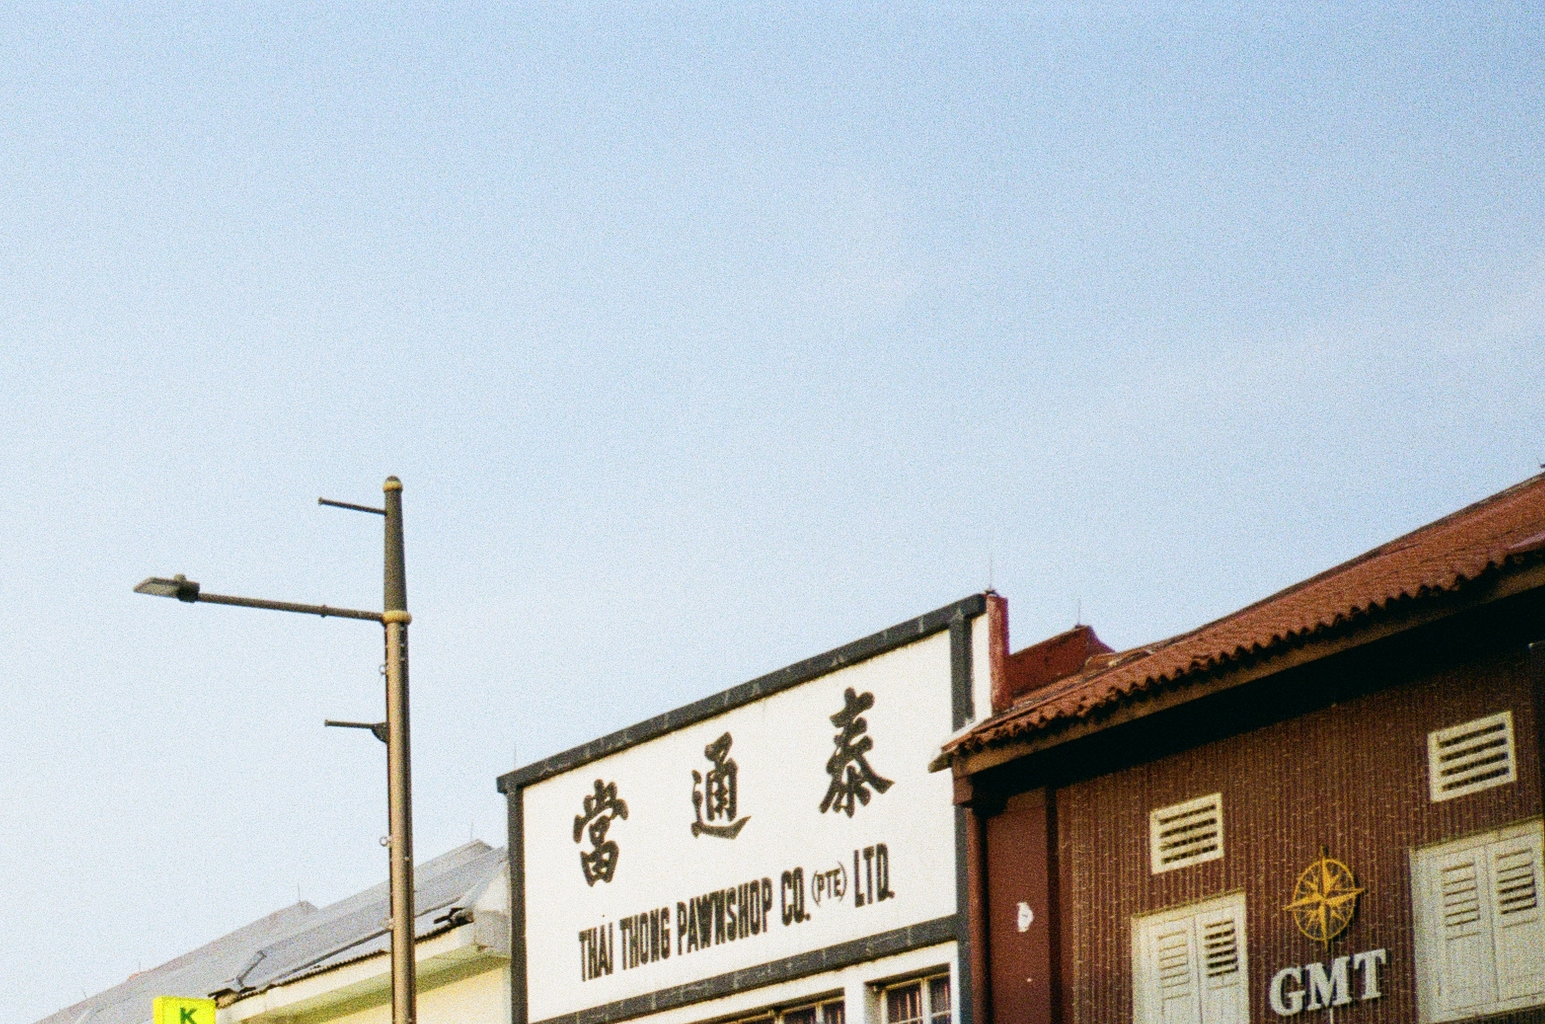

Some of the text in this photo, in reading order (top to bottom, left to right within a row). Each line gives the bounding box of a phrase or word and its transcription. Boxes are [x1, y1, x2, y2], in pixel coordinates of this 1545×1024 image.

[579, 843, 895, 982] THAI THONG PAWNSHOP CO. (PTE) LTD.
[1269, 949, 1387, 1017] GMT
